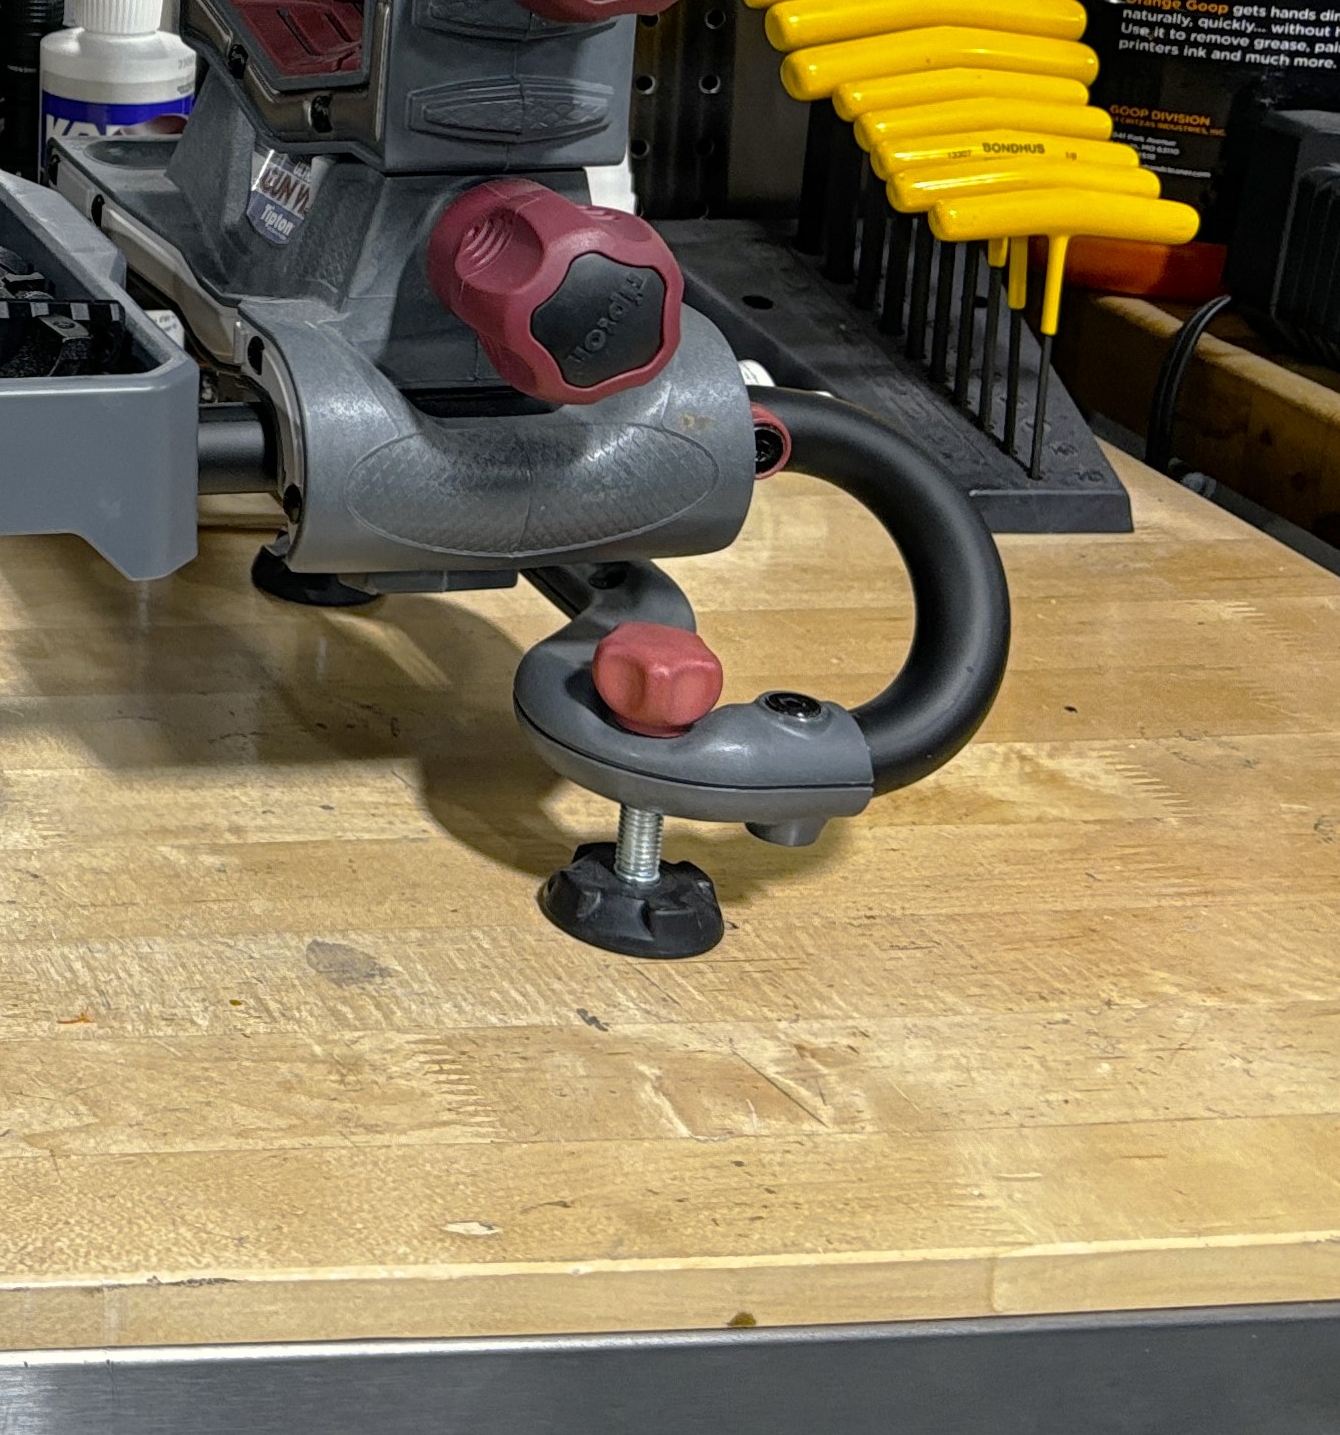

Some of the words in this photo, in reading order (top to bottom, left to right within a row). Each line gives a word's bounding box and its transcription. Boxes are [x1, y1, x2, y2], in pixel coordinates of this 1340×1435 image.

[1122, 8, 1193, 28] naturally,
[1271, 22, 1331, 37] without
[1232, 4, 1267, 19] gets
[1271, 5, 1317, 22] hands
[1120, 21, 1150, 37] Use
[1154, 25, 1165, 39] it
[1169, 27, 1186, 41] to
[1189, 32, 1250, 48] remove
[1253, 36, 1311, 54] grease,
[1118, 37, 1179, 56] printers
[1183, 44, 1207, 59] ink
[1211, 46, 1242, 62] and
[1245, 51, 1290, 67] much
[1293, 56, 1337, 69] more.
[1109, 104, 1149, 118] GOOP
[1151, 109, 1211, 127] DIVISION
[981, 142, 1046, 155] BONDHUS
[260, 203, 296, 237] Tipton
